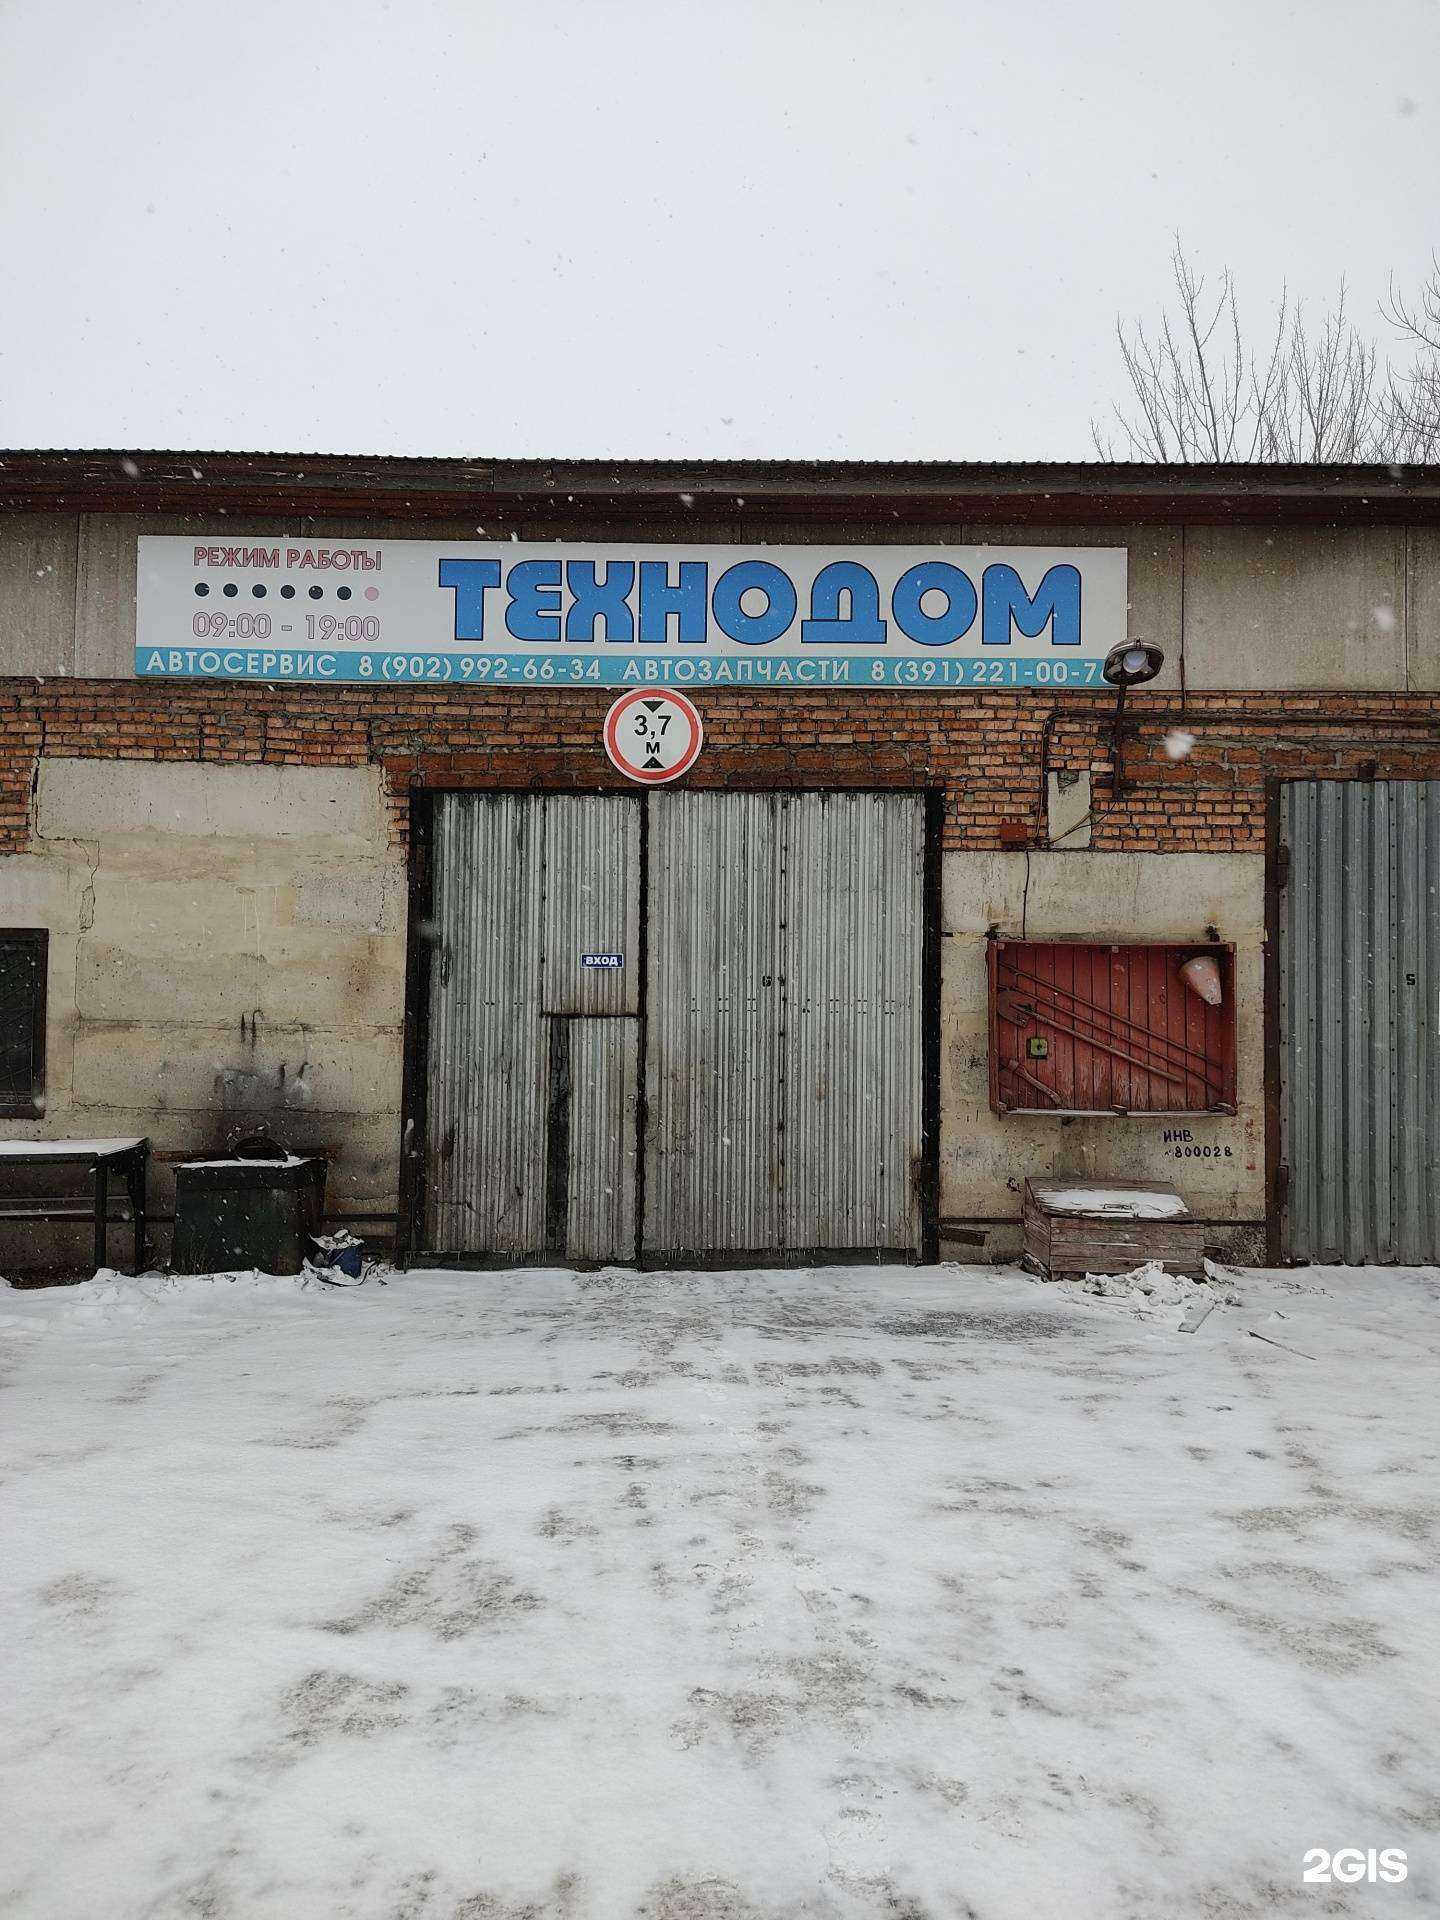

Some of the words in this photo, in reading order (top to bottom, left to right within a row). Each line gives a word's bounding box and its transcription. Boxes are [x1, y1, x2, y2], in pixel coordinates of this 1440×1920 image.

[194, 546, 280, 568] РЕЖИМ
[286, 550, 382, 571] РАБОТЫ
[438, 558, 1082, 647] ТЕХНОДОМ
[192, 611, 272, 638] 09:00
[305, 614, 381, 641] 19:00
[146, 650, 337, 676] АВТОСЕРВИС
[358, 655, 373, 677] 8
[382, 656, 452, 680] (902)
[460, 657, 601, 680] 992-66-34
[622, 659, 849, 681] АВТОЗАПЧАСТИ
[871, 660, 885, 681] 8
[894, 661, 964, 684] (391)
[972, 661, 1107, 683] 221-00-7
[634, 714, 672, 740] 3,7
[585, 956, 619, 967] ВХОД
[1163, 1129, 1194, 1143] ИНВ
